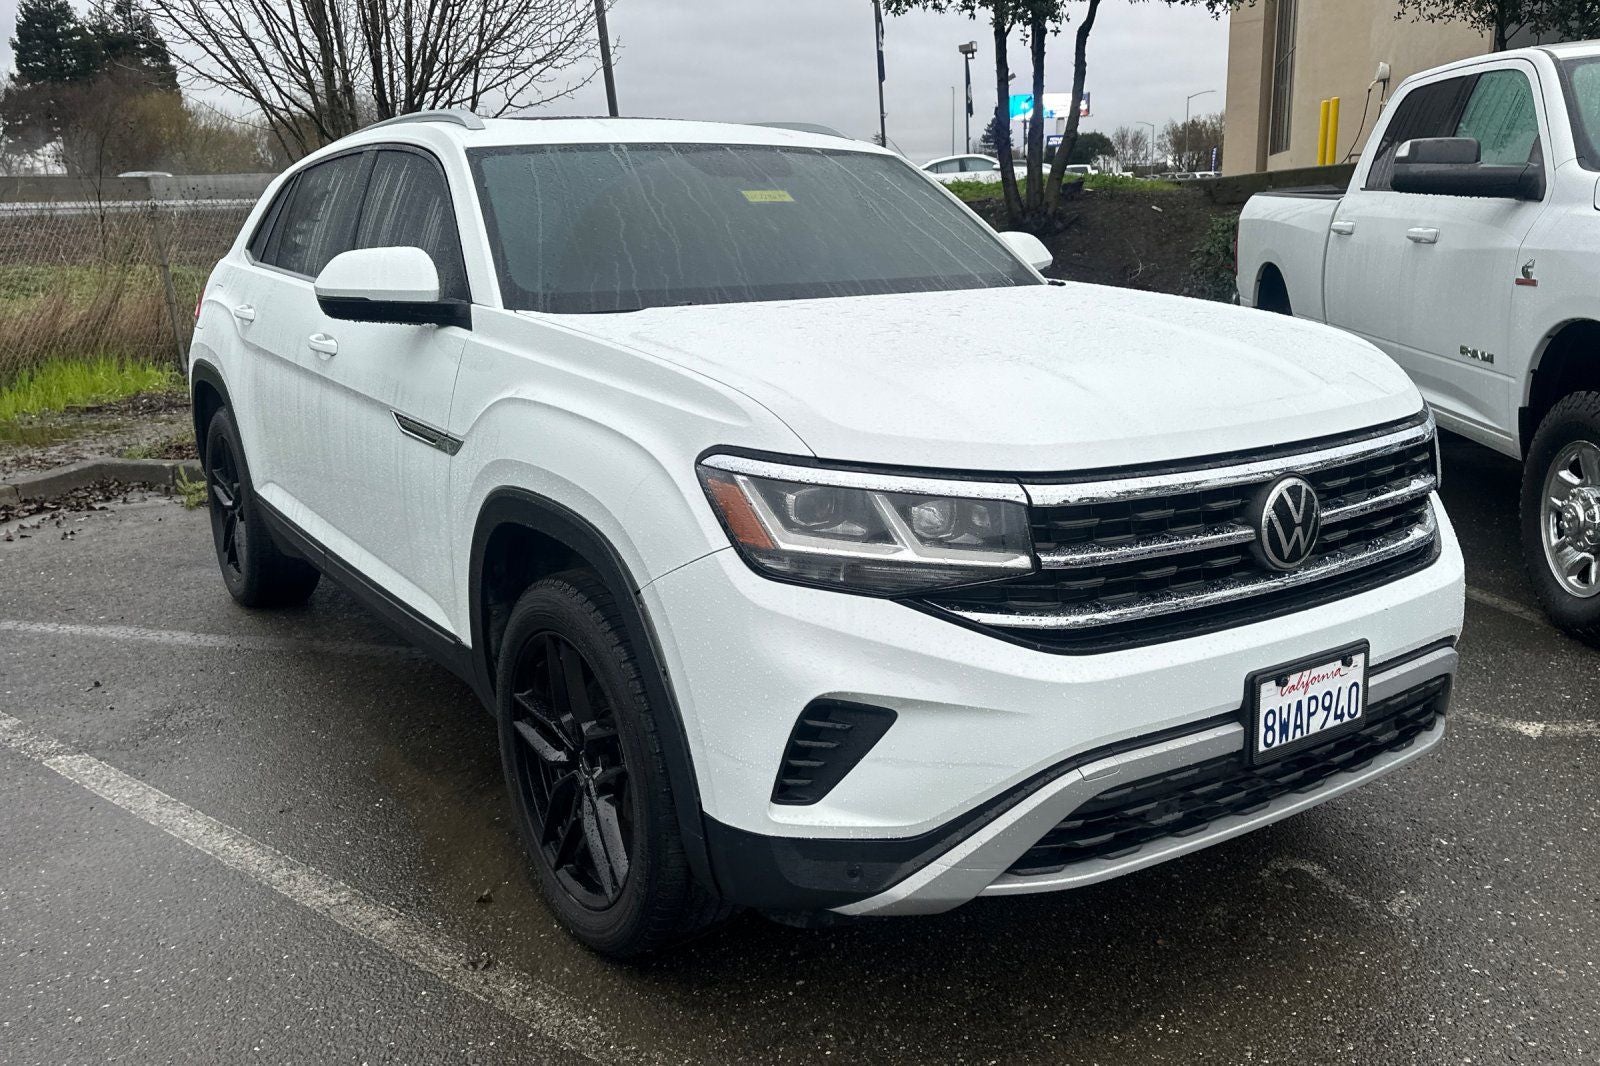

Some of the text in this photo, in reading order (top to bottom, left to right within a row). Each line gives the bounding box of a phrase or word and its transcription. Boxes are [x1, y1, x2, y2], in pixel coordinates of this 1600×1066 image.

[1460, 345, 1494, 364] RAM
[1280, 666, 1348, 697] California
[1263, 681, 1360, 749] 8WAP940
